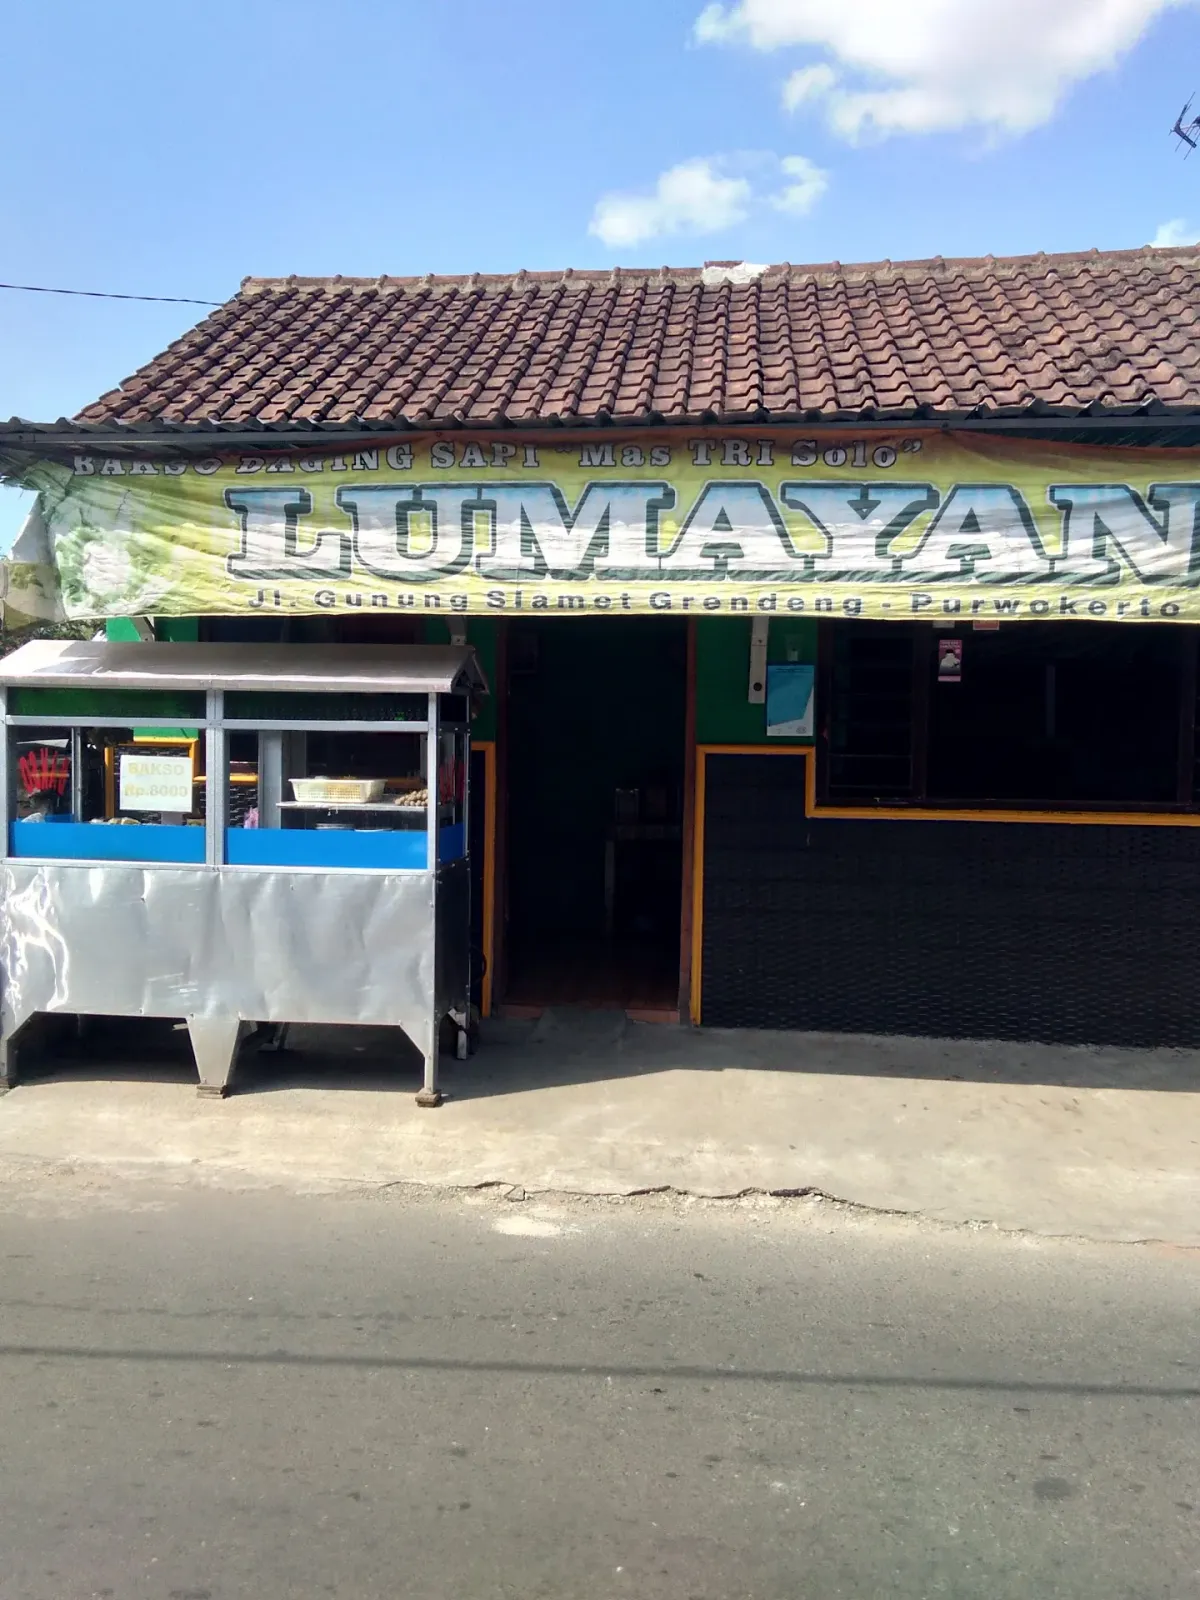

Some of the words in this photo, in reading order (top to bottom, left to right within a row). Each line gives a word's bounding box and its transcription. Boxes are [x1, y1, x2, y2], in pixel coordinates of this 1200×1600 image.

[431, 441, 540, 469] SAPI
[688, 439, 775, 467] TRI
[224, 482, 1200, 588] LUMAYAN
[314, 589, 468, 611] Gunung
[486, 589, 632, 610] Slamet
[649, 591, 862, 616] Grendeng
[911, 592, 1181, 618] Purwokerto
